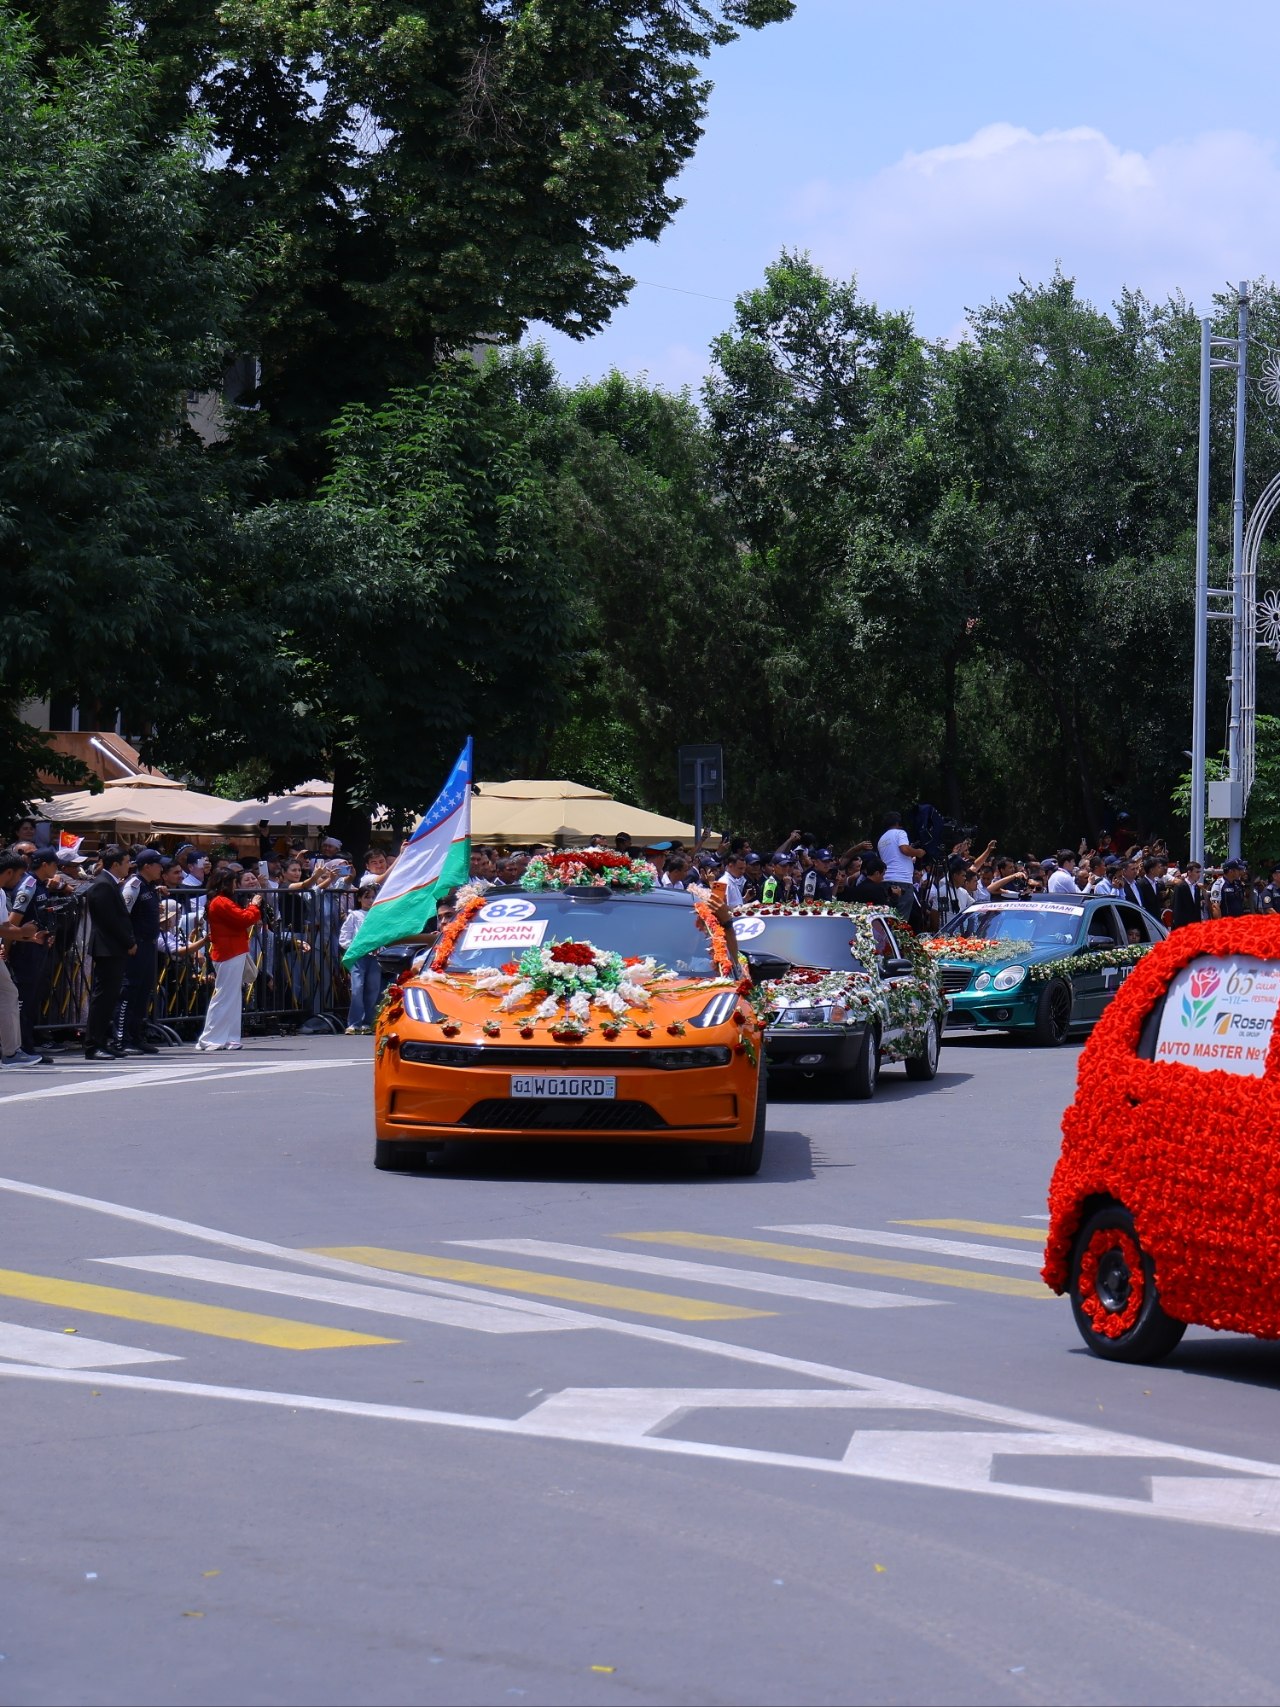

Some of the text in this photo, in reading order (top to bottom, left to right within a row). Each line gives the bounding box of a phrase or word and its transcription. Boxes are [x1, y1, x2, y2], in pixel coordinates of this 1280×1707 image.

[486, 904, 529, 918] 82
[1040, 903, 1075, 912] TUMANI
[481, 926, 533, 934] NORIN
[734, 923, 760, 935] 84
[473, 934, 535, 942] TUMANI
[1226, 968, 1257, 995] 65
[1158, 1042, 1190, 1055] AVTO
[1193, 1043, 1242, 1059] MASTER
[515, 1080, 531, 1093] 01
